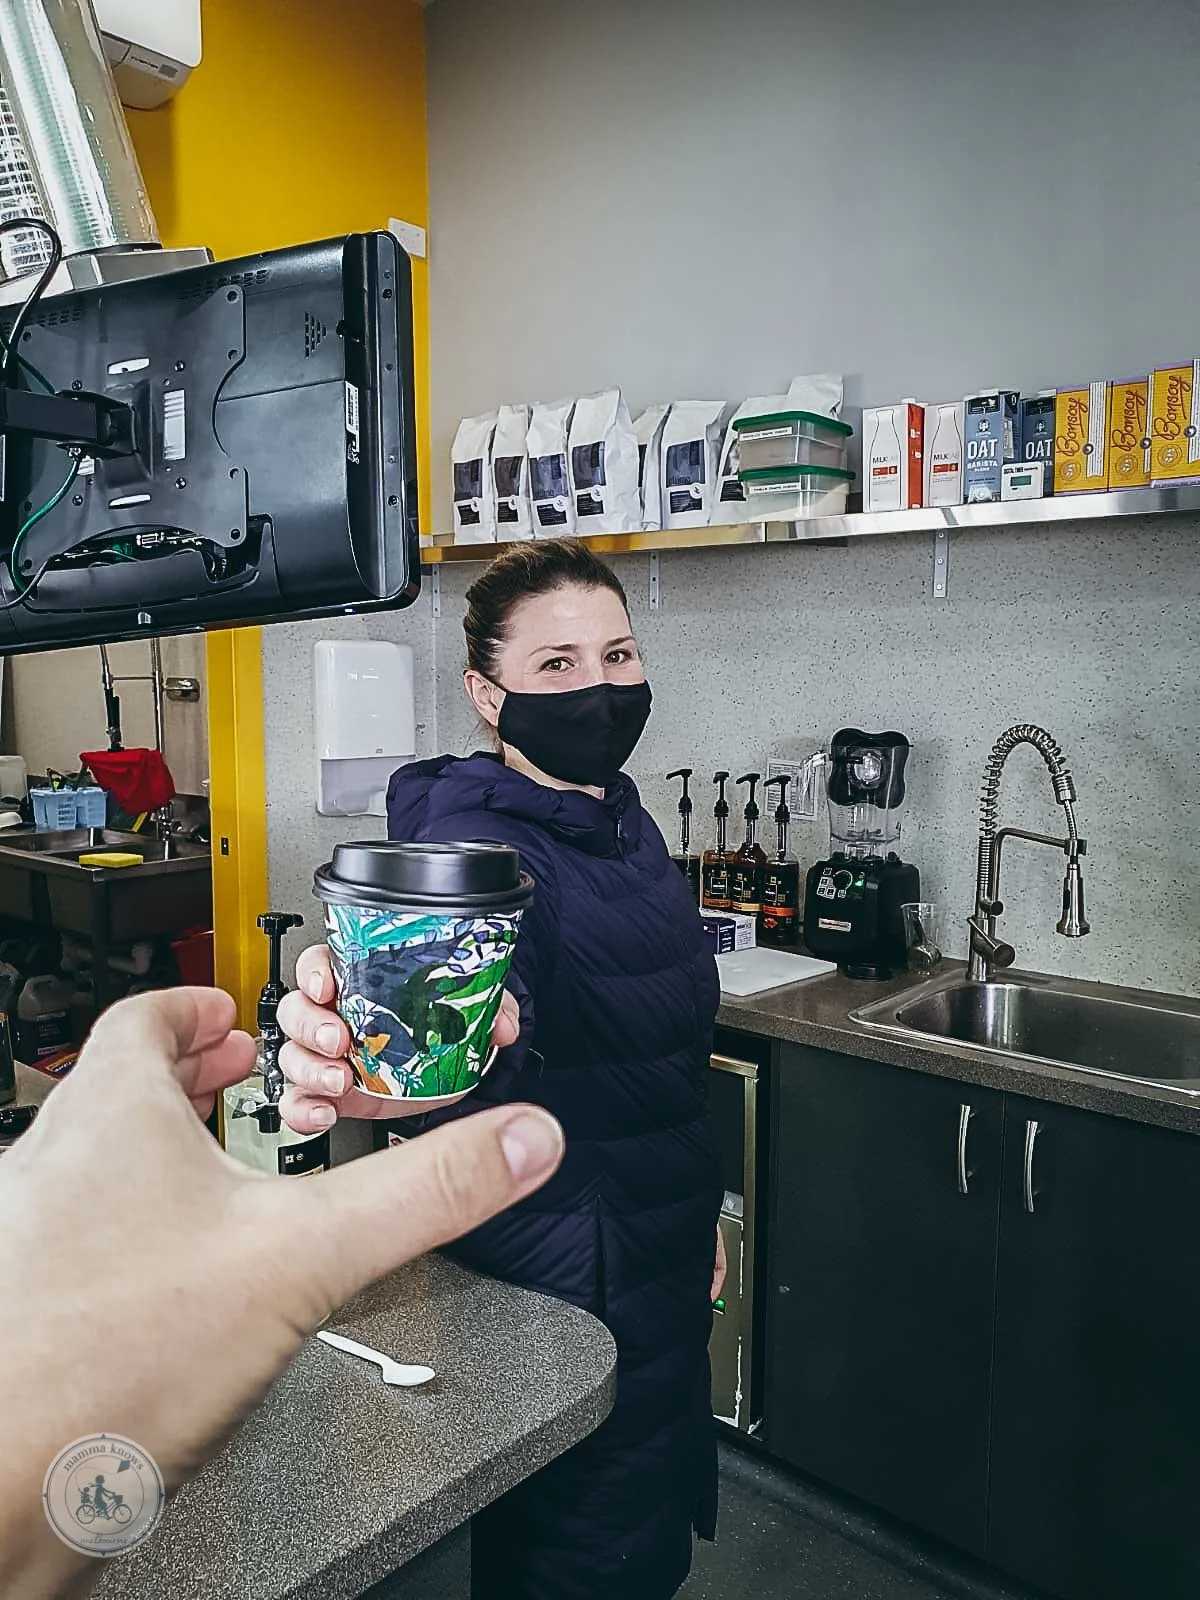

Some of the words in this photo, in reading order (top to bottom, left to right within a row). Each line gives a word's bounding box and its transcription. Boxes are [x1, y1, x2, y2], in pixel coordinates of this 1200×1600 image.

[1056, 396, 1089, 457] Bonsoy
[1112, 390, 1146, 452] Bonsoy
[1151, 375, 1191, 441] Bonsoy
[967, 438, 998, 460] OAT
[967, 460, 998, 469] BARISTA
[1025, 438, 1053, 460] OAT
